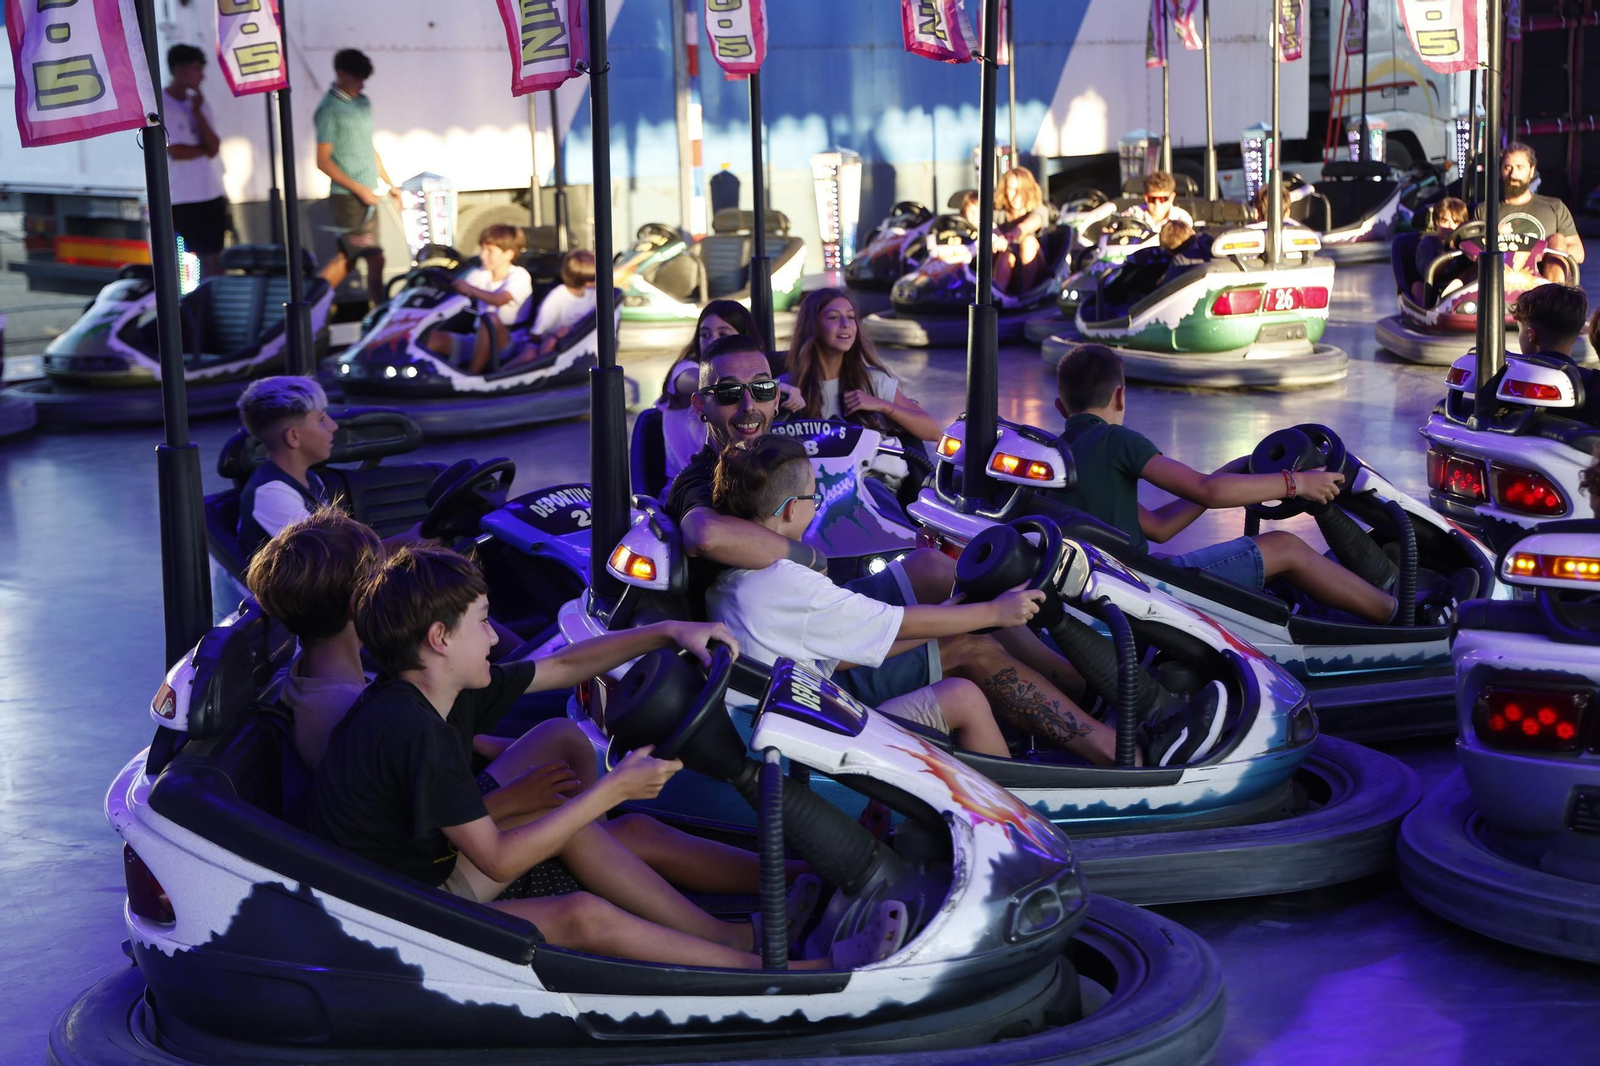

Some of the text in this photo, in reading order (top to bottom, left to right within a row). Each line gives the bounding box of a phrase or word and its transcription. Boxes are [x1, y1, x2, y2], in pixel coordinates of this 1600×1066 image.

[1275, 288, 1294, 310] 26
[839, 426, 847, 439] 5
[570, 508, 591, 528] 2
